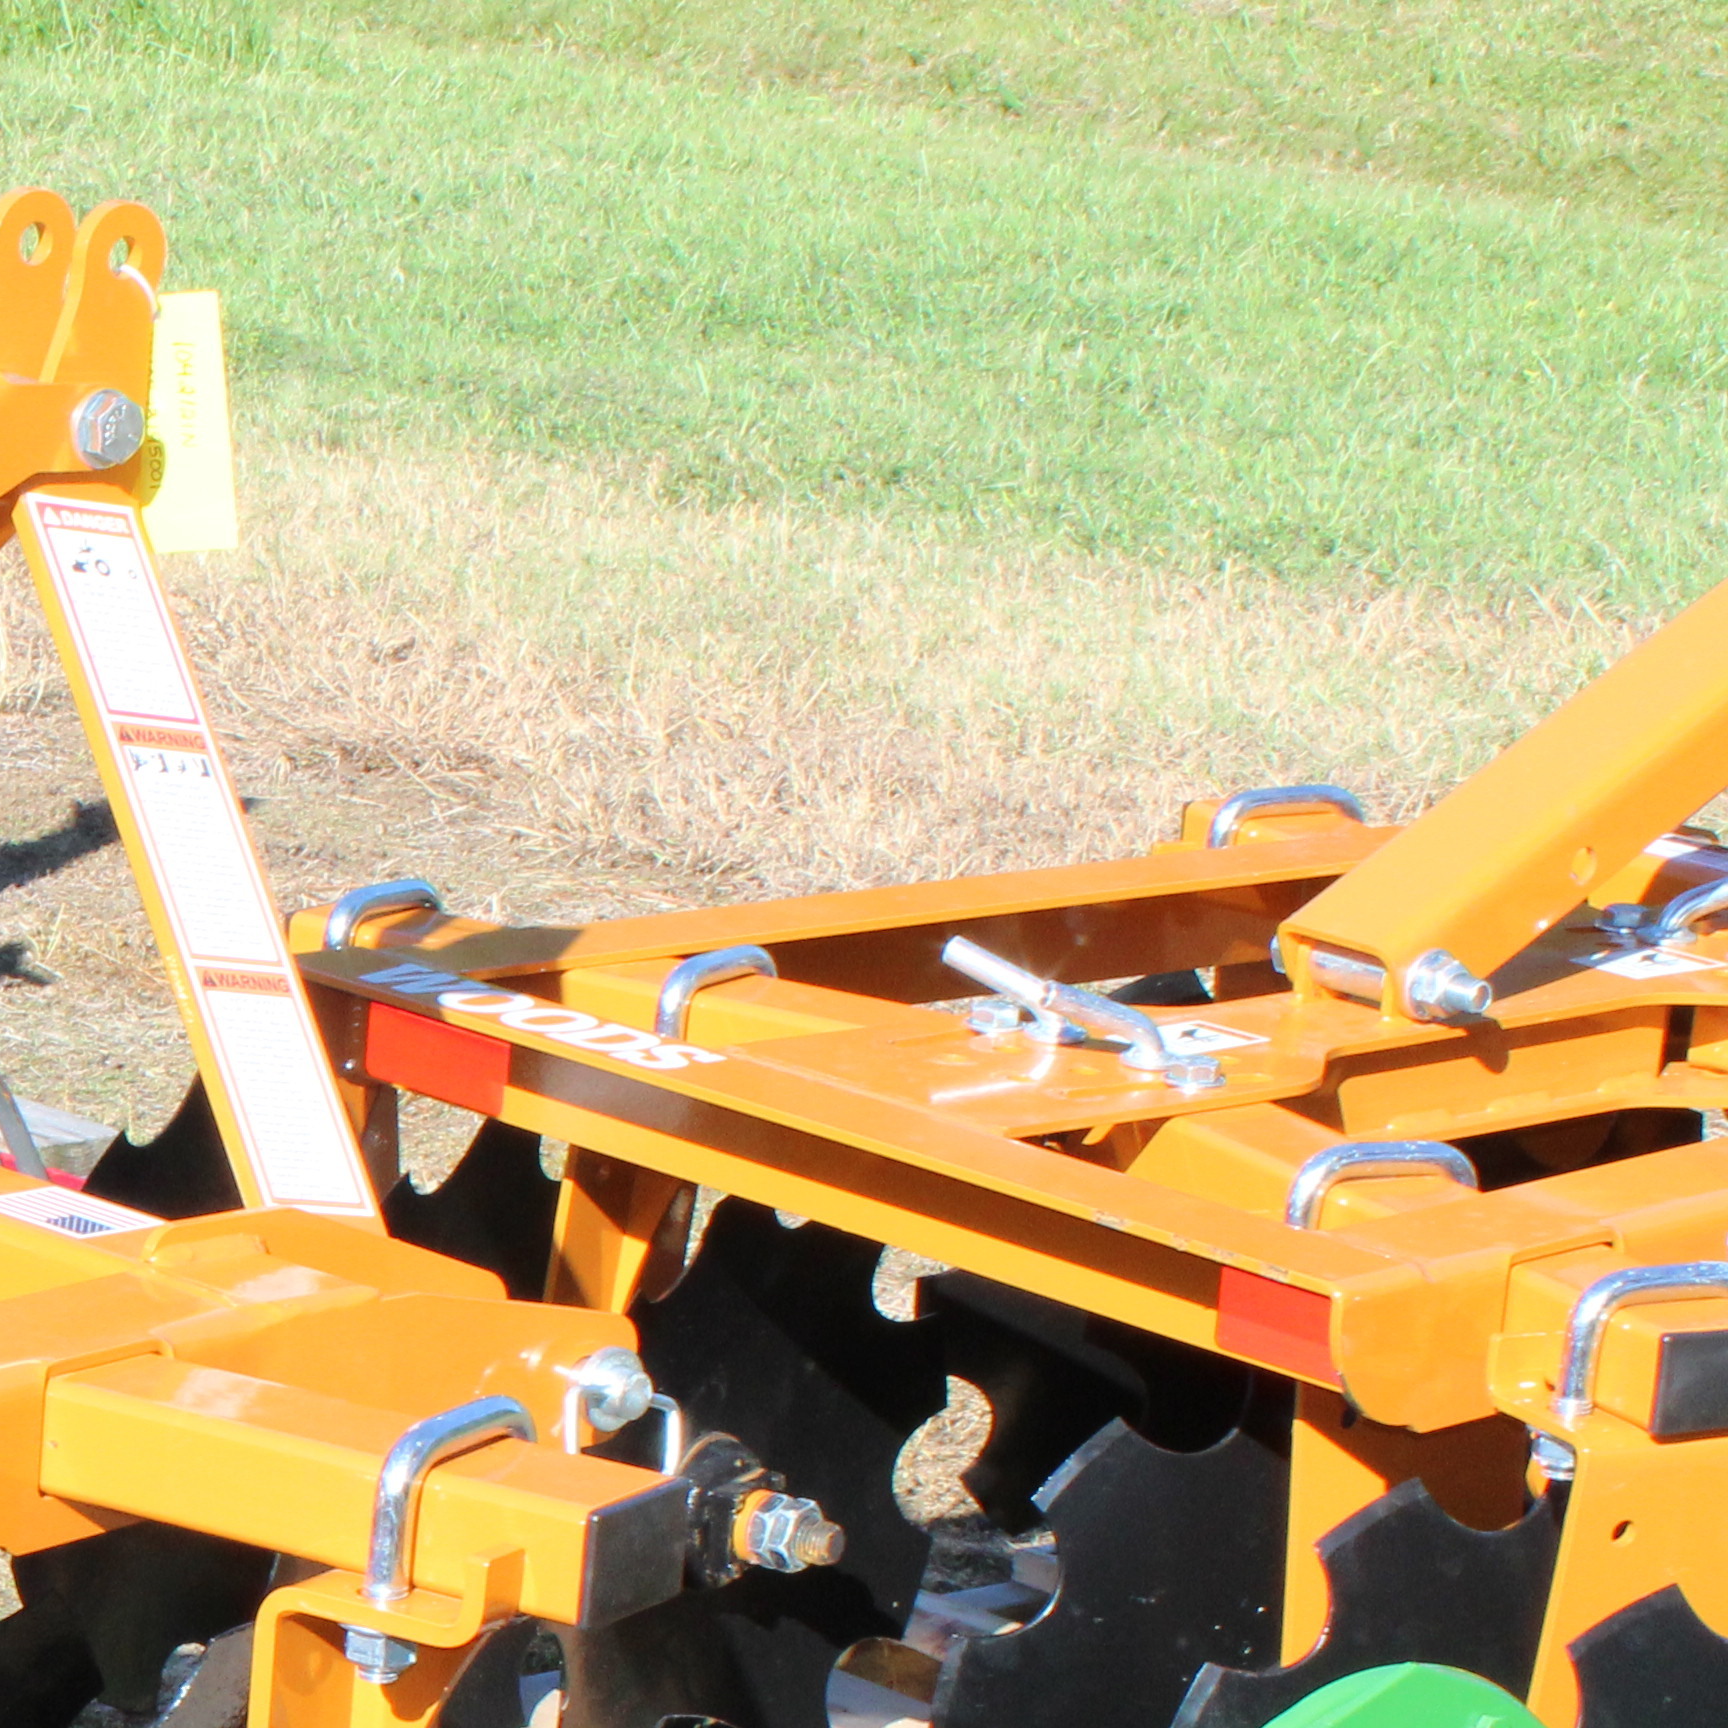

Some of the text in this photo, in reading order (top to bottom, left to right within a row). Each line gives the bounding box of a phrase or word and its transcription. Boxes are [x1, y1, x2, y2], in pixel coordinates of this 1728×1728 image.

[60, 510, 131, 534] DANGER
[130, 727, 207, 750] WARNING
[213, 971, 290, 993] WARNING
[358, 963, 728, 1070] WOODS
